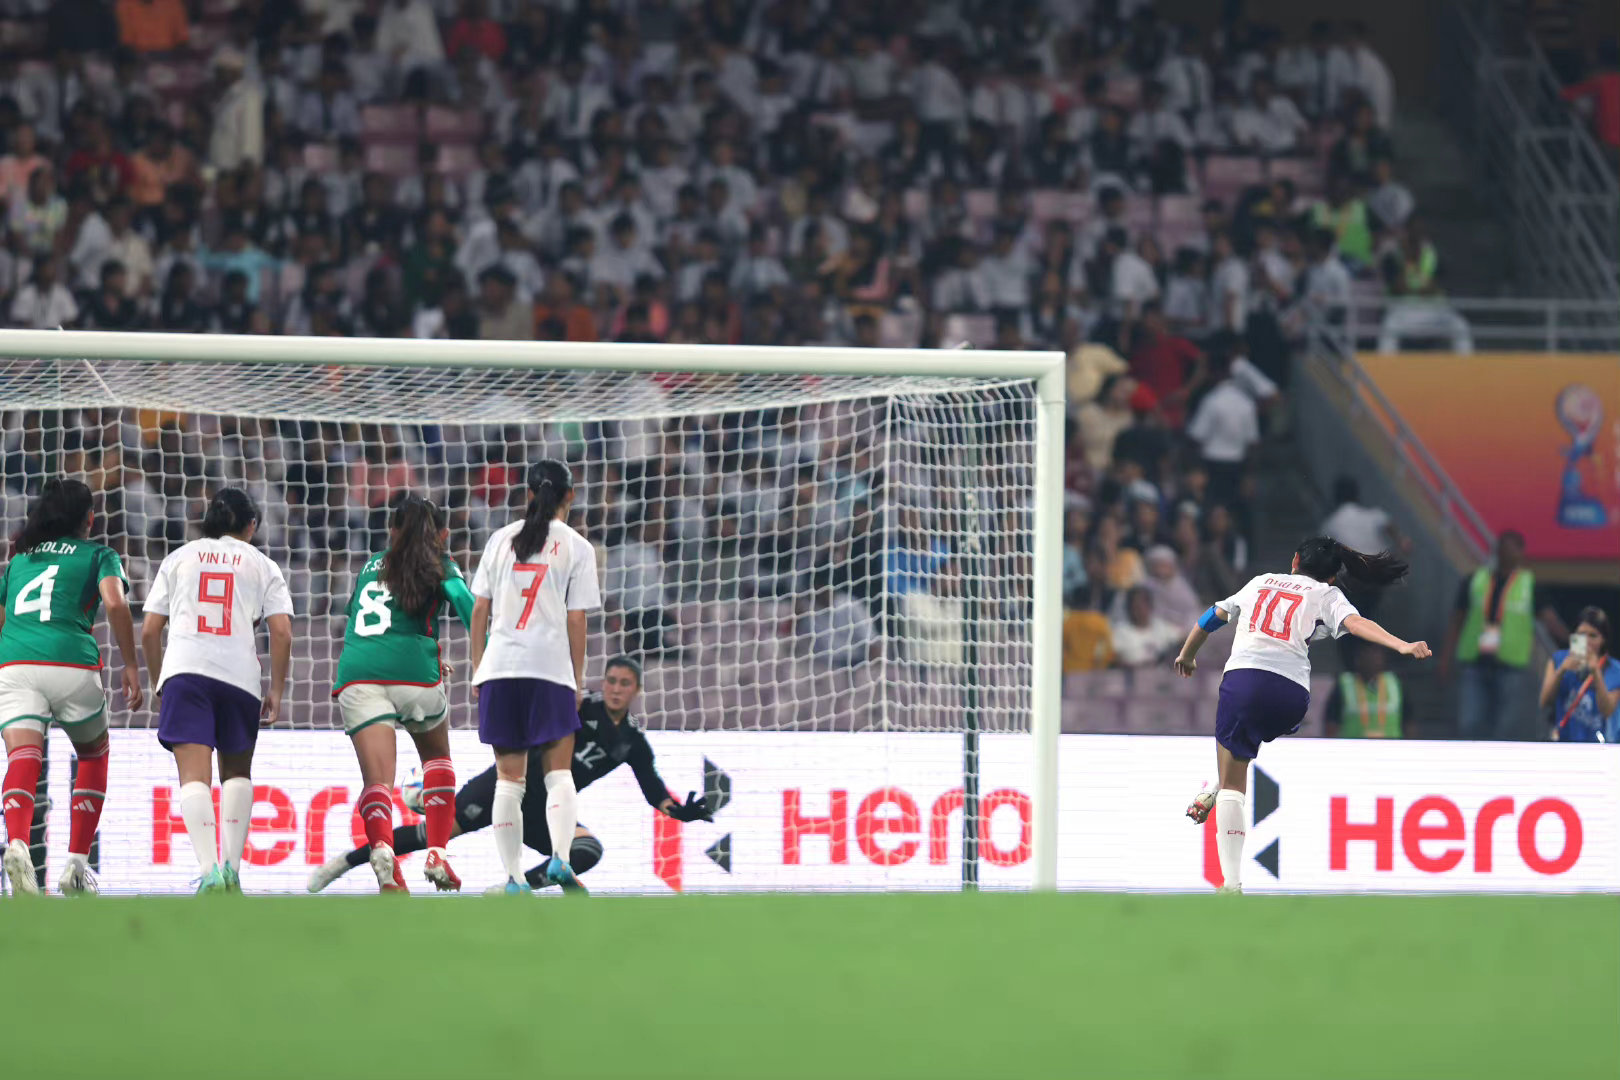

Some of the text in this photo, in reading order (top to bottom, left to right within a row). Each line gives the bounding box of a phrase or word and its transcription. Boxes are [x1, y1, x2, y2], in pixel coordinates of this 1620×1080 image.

[14, 564, 60, 622] 4
[198, 571, 235, 636] 9
[354, 580, 393, 636] 8
[512, 562, 549, 630] 7
[1249, 588, 1304, 641] 10
[782, 786, 1033, 868] Hero
[1328, 794, 1584, 875] Hero
